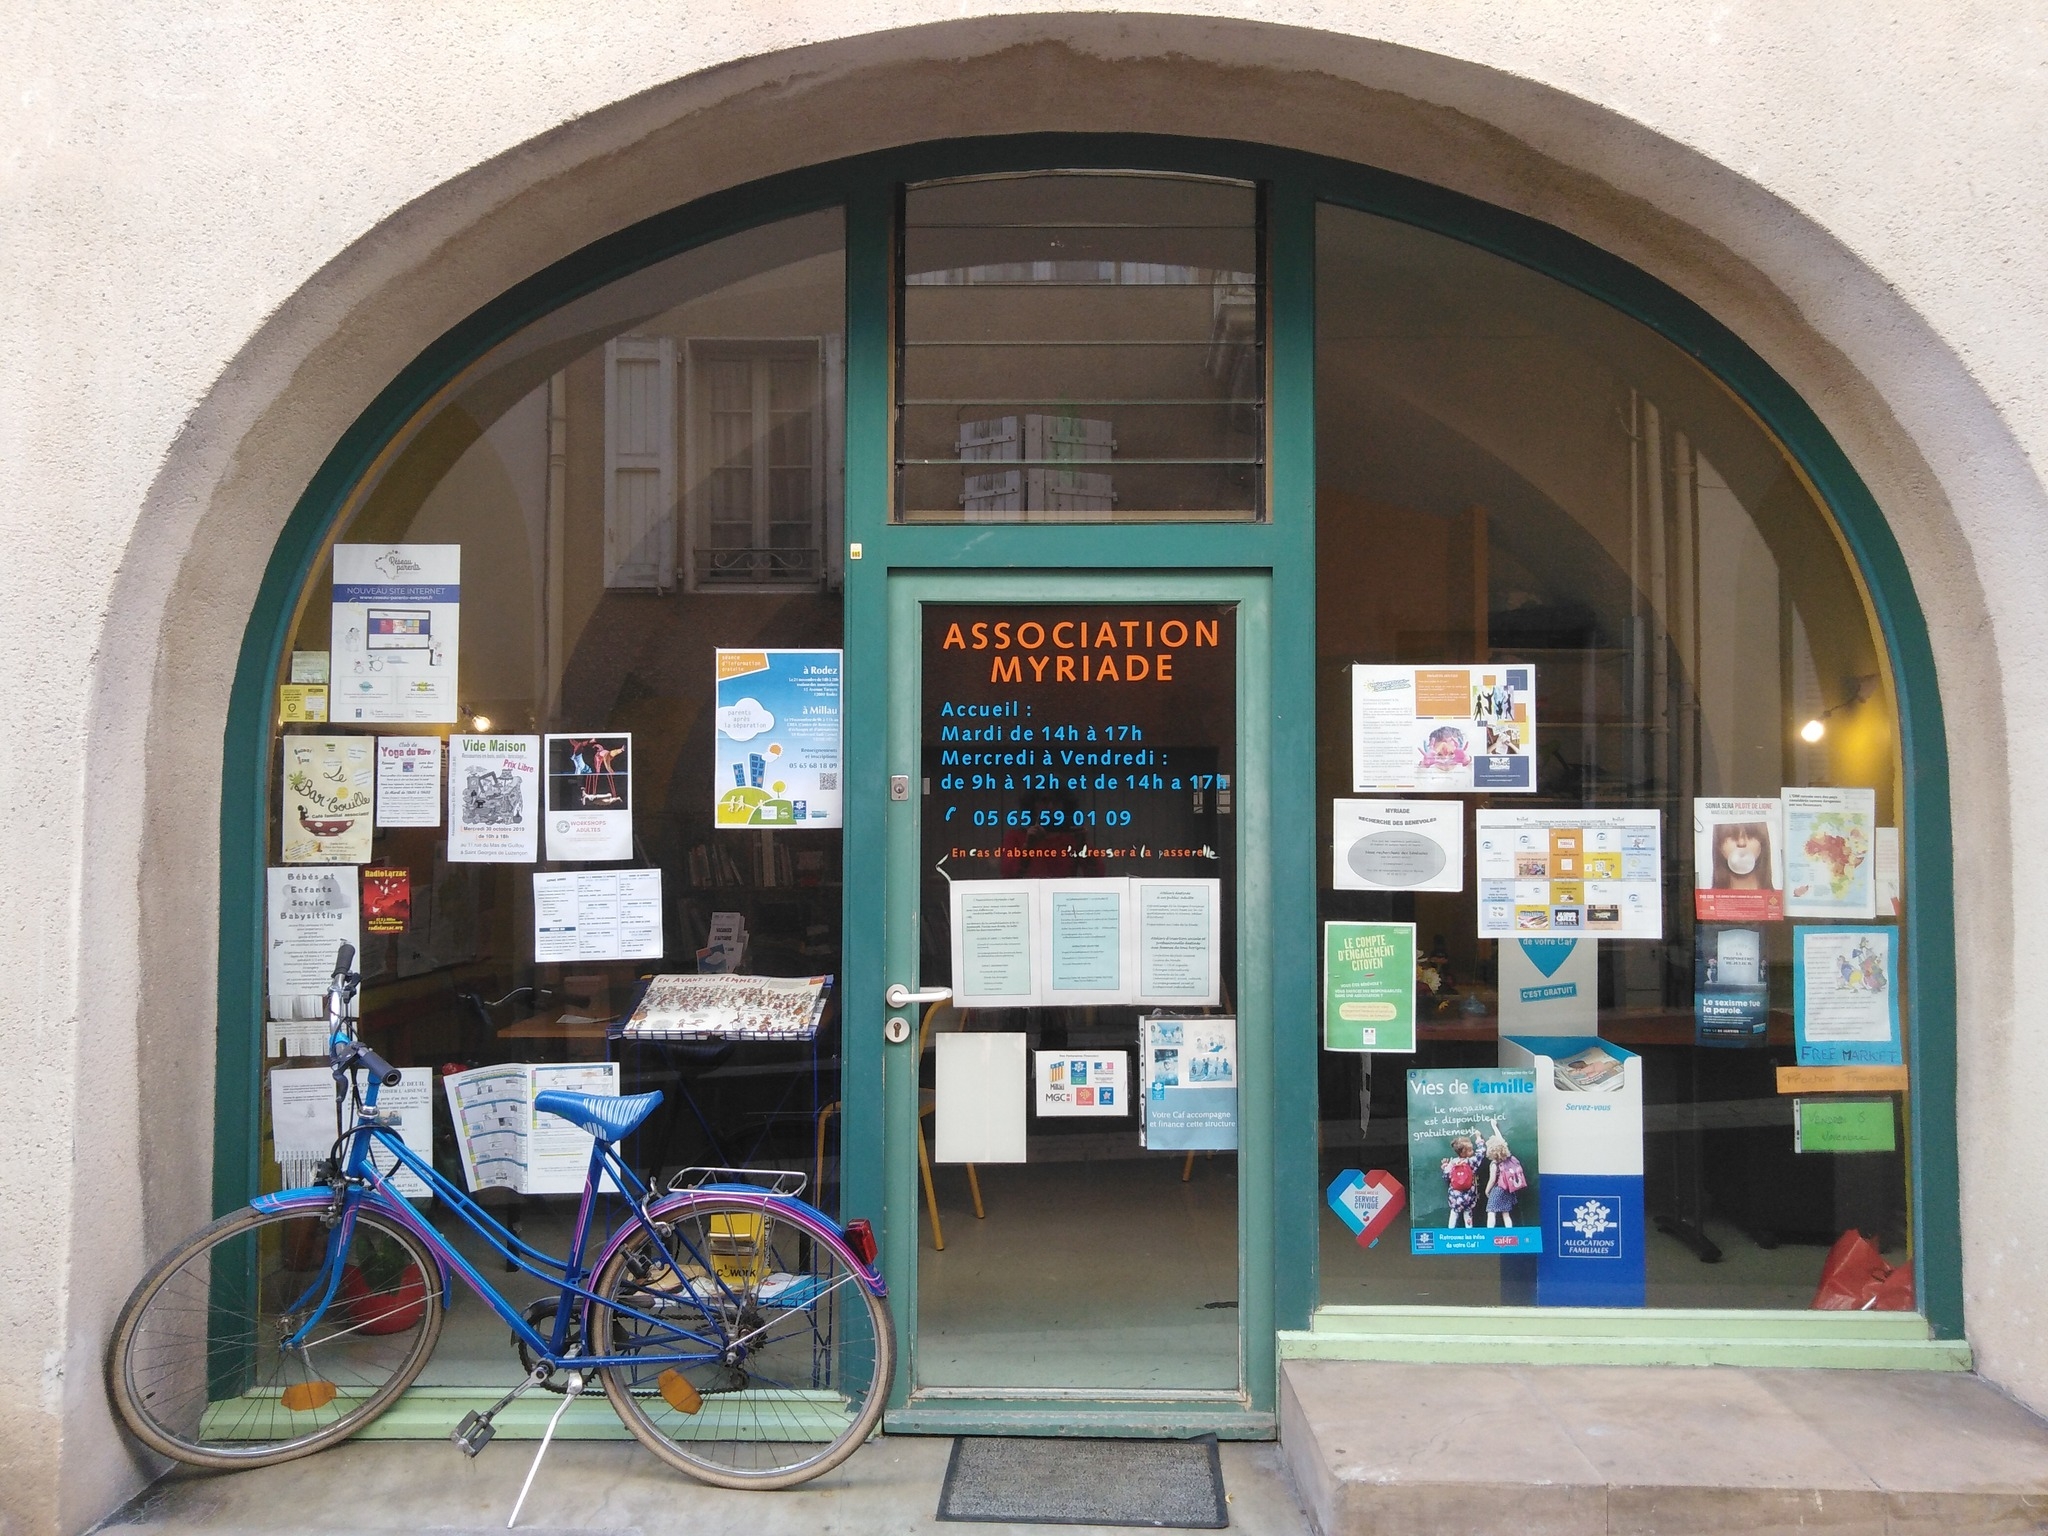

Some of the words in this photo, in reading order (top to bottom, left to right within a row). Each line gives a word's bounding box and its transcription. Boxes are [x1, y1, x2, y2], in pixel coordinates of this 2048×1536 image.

[397, 562, 421, 574] parents
[943, 620, 1219, 650] ASSOCIATION
[804, 666, 809, 675] à
[810, 666, 838, 675] Rodez
[991, 655, 1173, 683] MYRIADE
[803, 706, 808, 715] à
[810, 706, 837, 715] Millau
[942, 701, 1018, 717] Accueil
[942, 725, 1002, 741] Mardi
[1010, 726, 1034, 741] de
[1042, 725, 1079, 741] 14h
[1086, 725, 1097, 741] à
[1105, 725, 1142, 741] 17h
[463, 739, 486, 752] Vide
[490, 740, 526, 752] Maison
[381, 746, 404, 759] Yoga
[406, 748, 416, 756] du
[942, 750, 1034, 766] Mercredi
[1042, 750, 1053, 766] à
[1061, 750, 1154, 766] Vendredi
[503, 758, 517, 770] Prix
[517, 762, 534, 773] Libre
[323, 766, 347, 783] Le
[941, 774, 965, 790] de
[972, 774, 996, 790] 9h
[1004, 774, 1014, 790] à
[1022, 774, 1059, 790] 12h
[1068, 775, 1087, 790] et
[1094, 774, 1118, 790] de
[1126, 774, 1163, 790] 14h
[1190, 774, 1227, 790] 17h
[974, 810, 998, 826] 05
[1007, 810, 1032, 826] 65
[1040, 810, 1065, 826] 59
[1073, 810, 1097, 826] 01
[1106, 810, 1131, 826] 09
[1358, 816, 1391, 826] RECHERCHE
[952, 848, 966, 858] En
[970, 849, 990, 858] cas
[994, 847, 1057, 858] d'absence
[1130, 846, 1136, 858] à
[1140, 845, 1151, 858] la
[288, 872, 319, 881] Bébés
[365, 870, 407, 879] RadioLarzac
[291, 886, 332, 894] Enfants
[280, 912, 343, 920] Babysitting
[1344, 938, 1354, 949] LE
[1356, 935, 1386, 948] COMPTE
[1522, 938, 1532, 946] de
[1338, 945, 1395, 962] D'ENGAGEMENT
[1352, 957, 1384, 971] CITOYEN
[1522, 989, 1542, 999] C'EST
[1544, 986, 1574, 997] GRATUIT
[1714, 1007, 1743, 1015] parole.
[1802, 1046, 1836, 1060] FREE
[1842, 1050, 1898, 1062] MARKET
[1410, 1080, 1444, 1096] Vies
[1449, 1079, 1469, 1095] de
[1472, 1078, 1534, 1094] famille
[1046, 1094, 1066, 1102] MGC
[1434, 1106, 1446, 1114] Le
[1449, 1103, 1494, 1115] magazine
[1565, 1103, 1611, 1112] Servez-vous
[1152, 1111, 1171, 1119] Votre
[1173, 1111, 1186, 1119] Caf
[1187, 1112, 1231, 1120] accompagne
[1442, 1113, 1492, 1128] disponible
[1494, 1113, 1506, 1121] ici
[1205, 1120, 1236, 1128] structure
[1413, 1126, 1477, 1141] gratuitement
[1354, 1195, 1379, 1203] SERVICE
[1354, 1202, 1379, 1210] CIVIQUE
